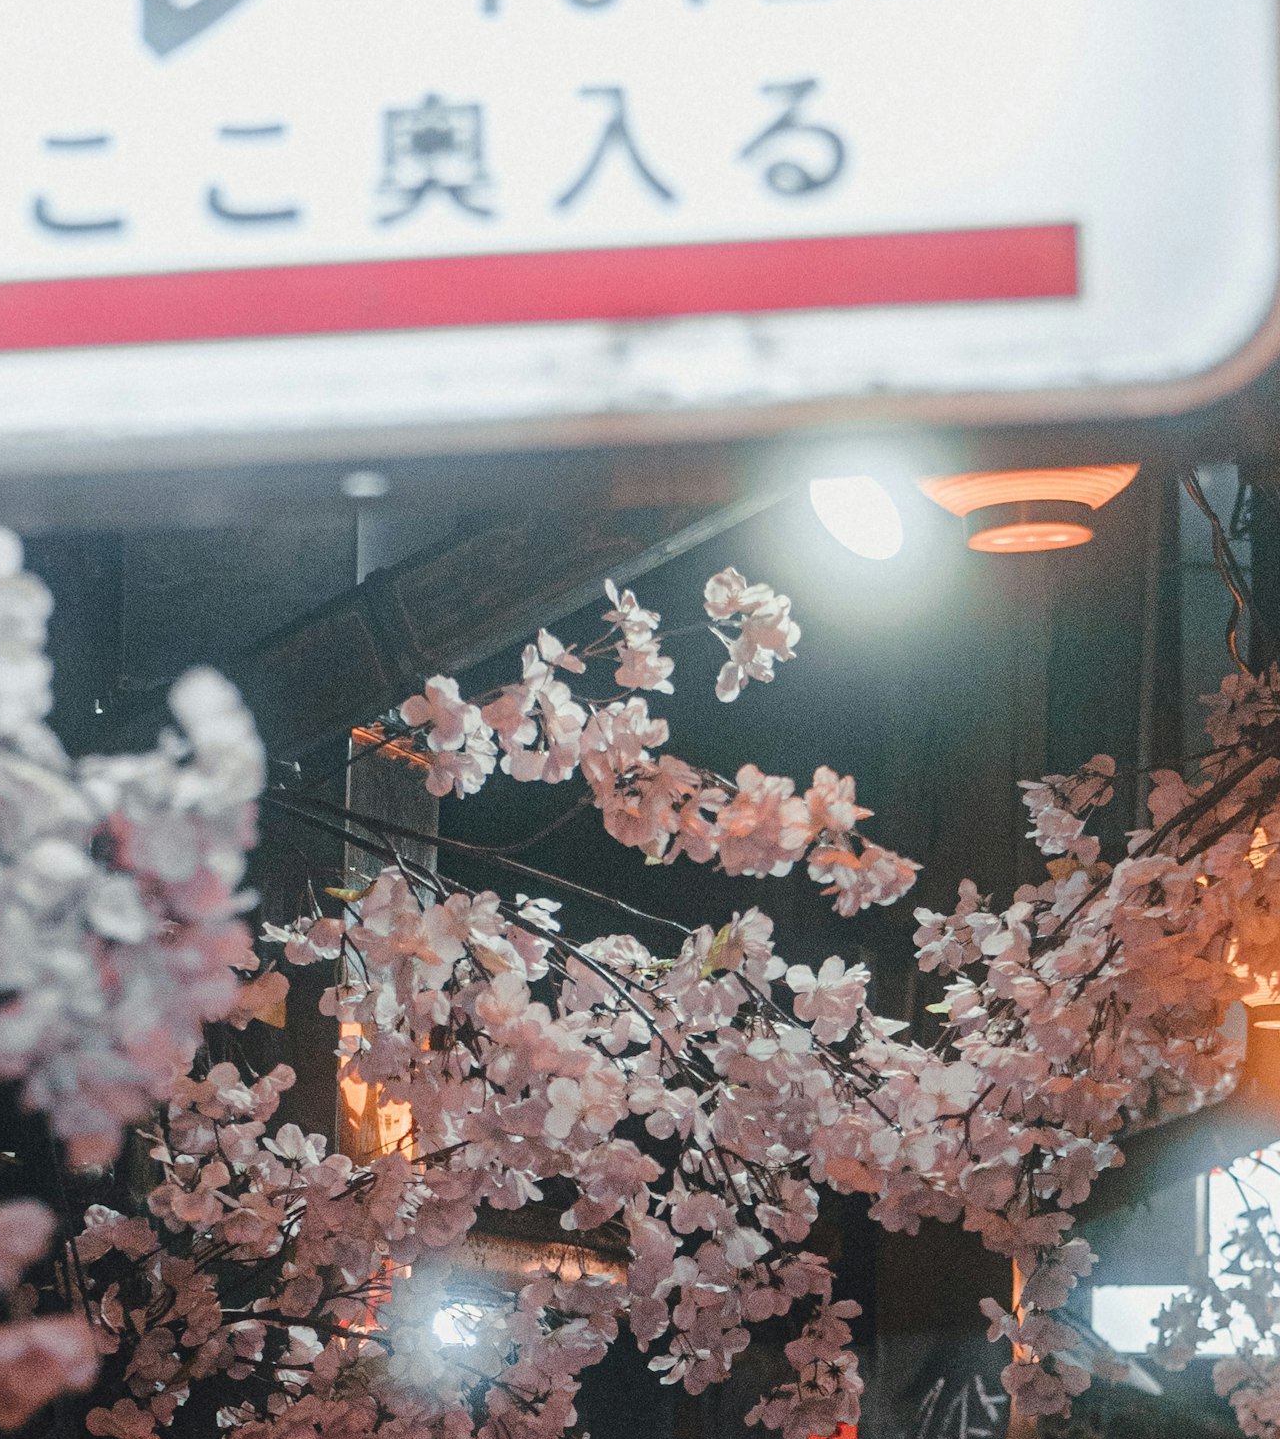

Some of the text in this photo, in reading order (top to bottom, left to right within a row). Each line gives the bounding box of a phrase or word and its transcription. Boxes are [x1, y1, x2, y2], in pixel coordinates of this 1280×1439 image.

[30, 77, 853, 239] ここ奥入る
